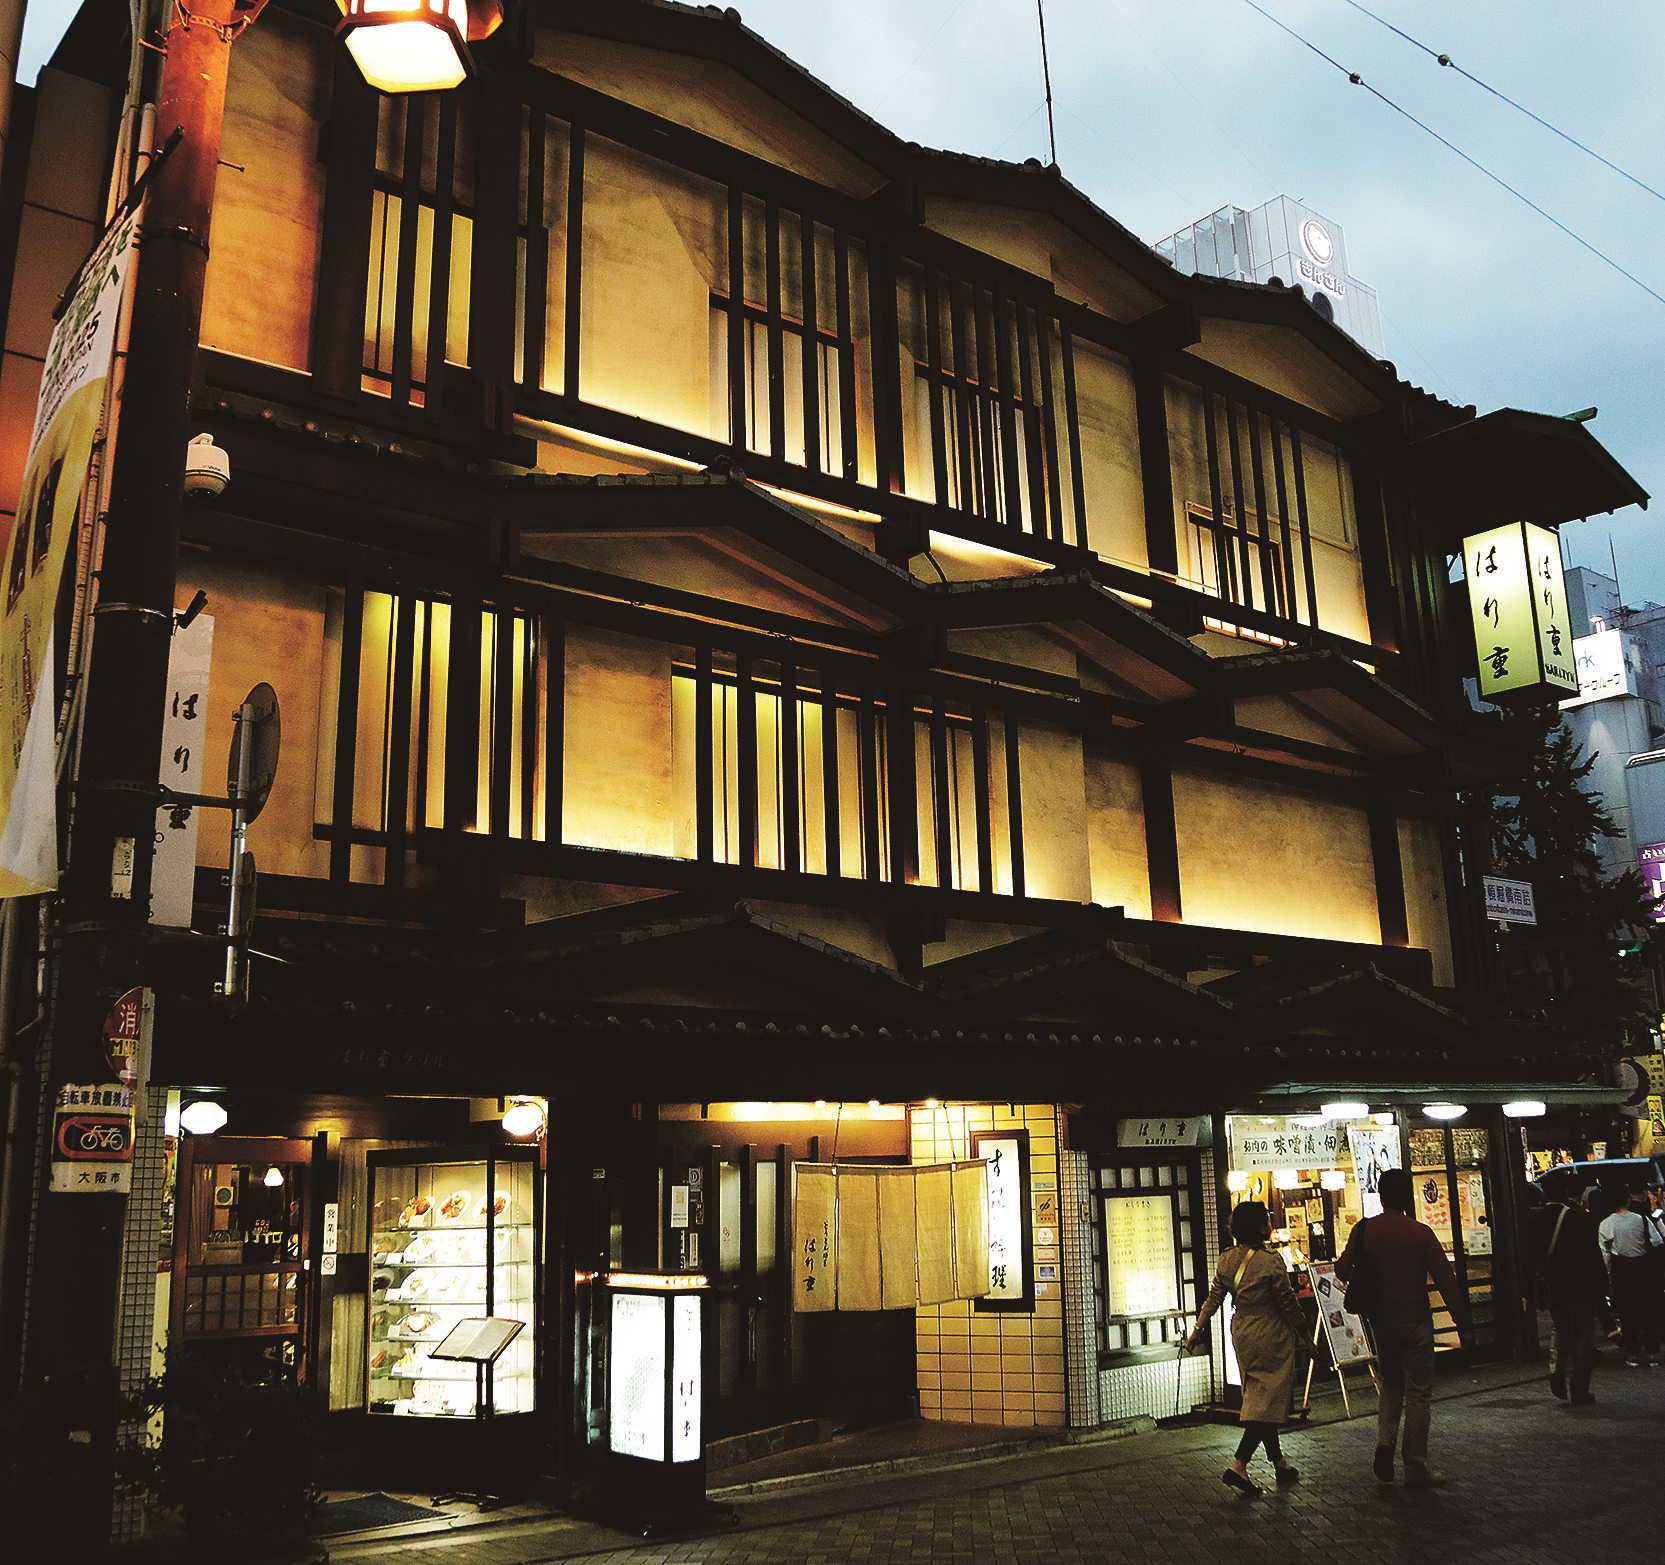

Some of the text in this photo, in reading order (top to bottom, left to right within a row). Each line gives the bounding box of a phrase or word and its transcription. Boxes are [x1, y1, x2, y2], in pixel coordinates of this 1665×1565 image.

[1476, 546, 1510, 680] はり重
[1538, 553, 1562, 657] はり重
[162, 691, 199, 830] はり重
[118, 1002, 140, 1036] 消
[1138, 1121, 1187, 1137] はり重
[78, 1171, 121, 1185] 大阪市
[326, 1208, 336, 1248] 営業中
[802, 1237, 817, 1292] はり重
